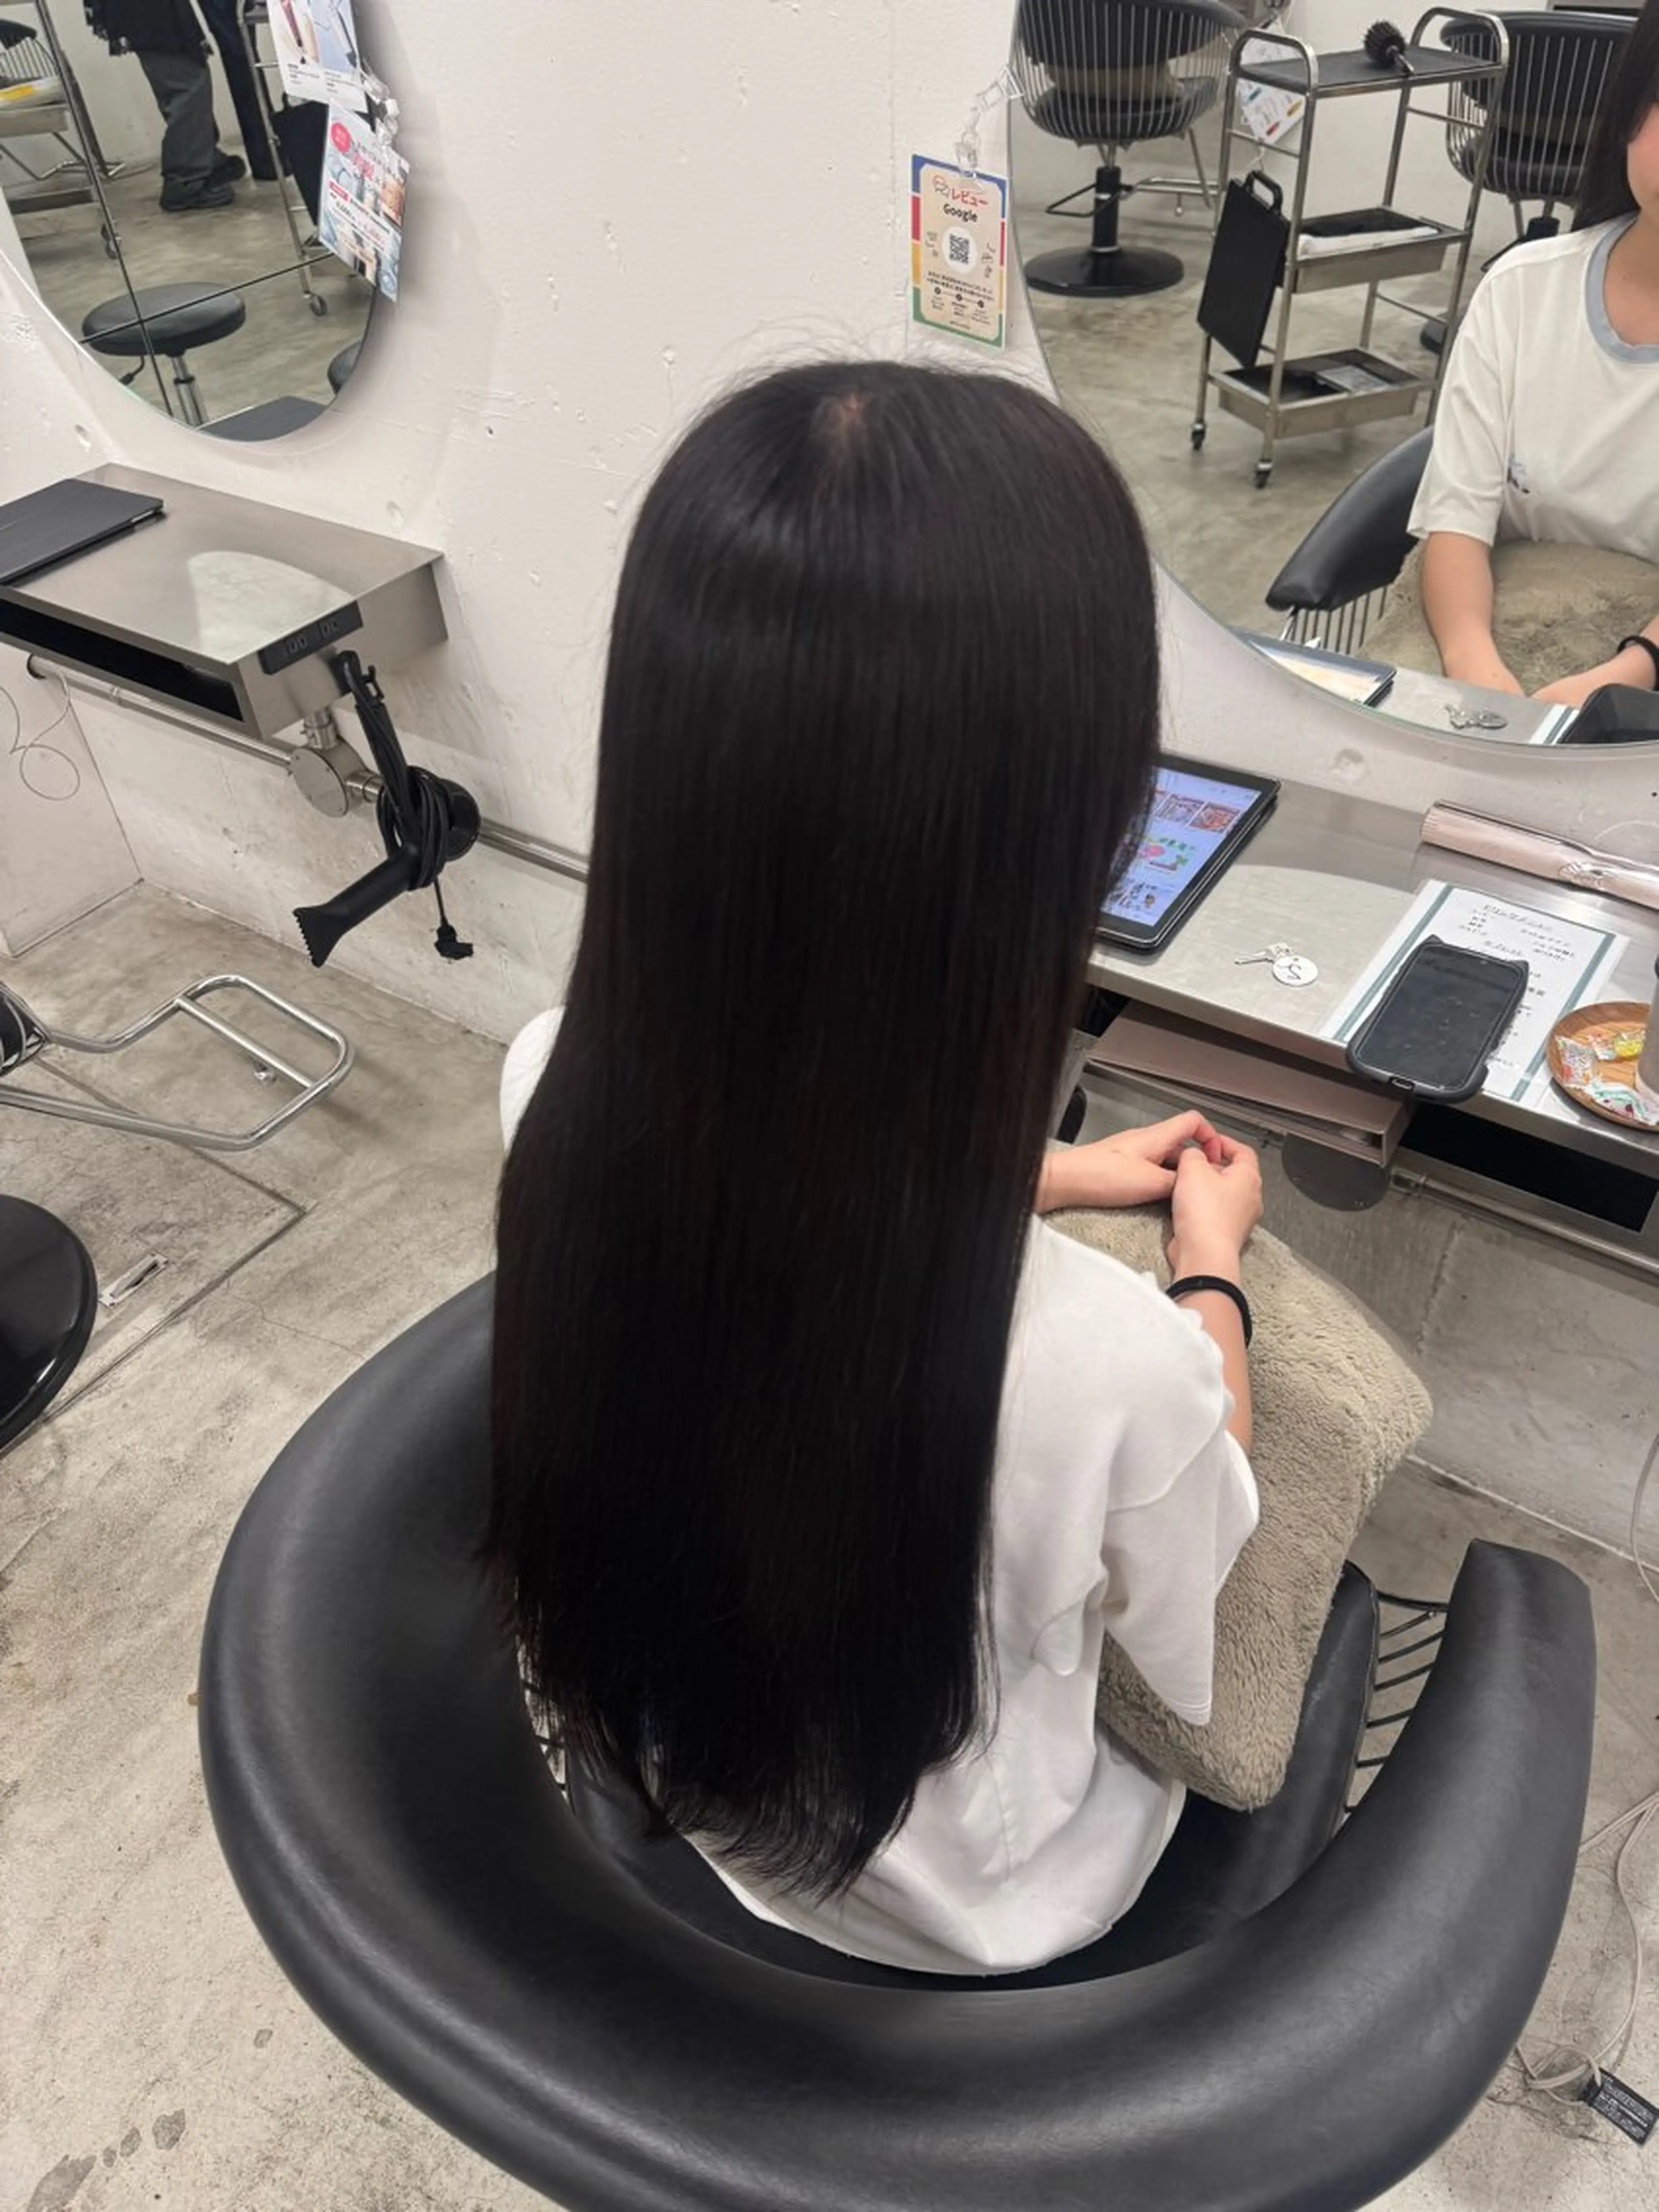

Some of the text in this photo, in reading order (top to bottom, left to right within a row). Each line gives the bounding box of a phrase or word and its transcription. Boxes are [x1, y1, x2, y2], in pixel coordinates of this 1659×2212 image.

[951, 188, 988, 207] レビュー
[943, 203, 978, 222] Google
